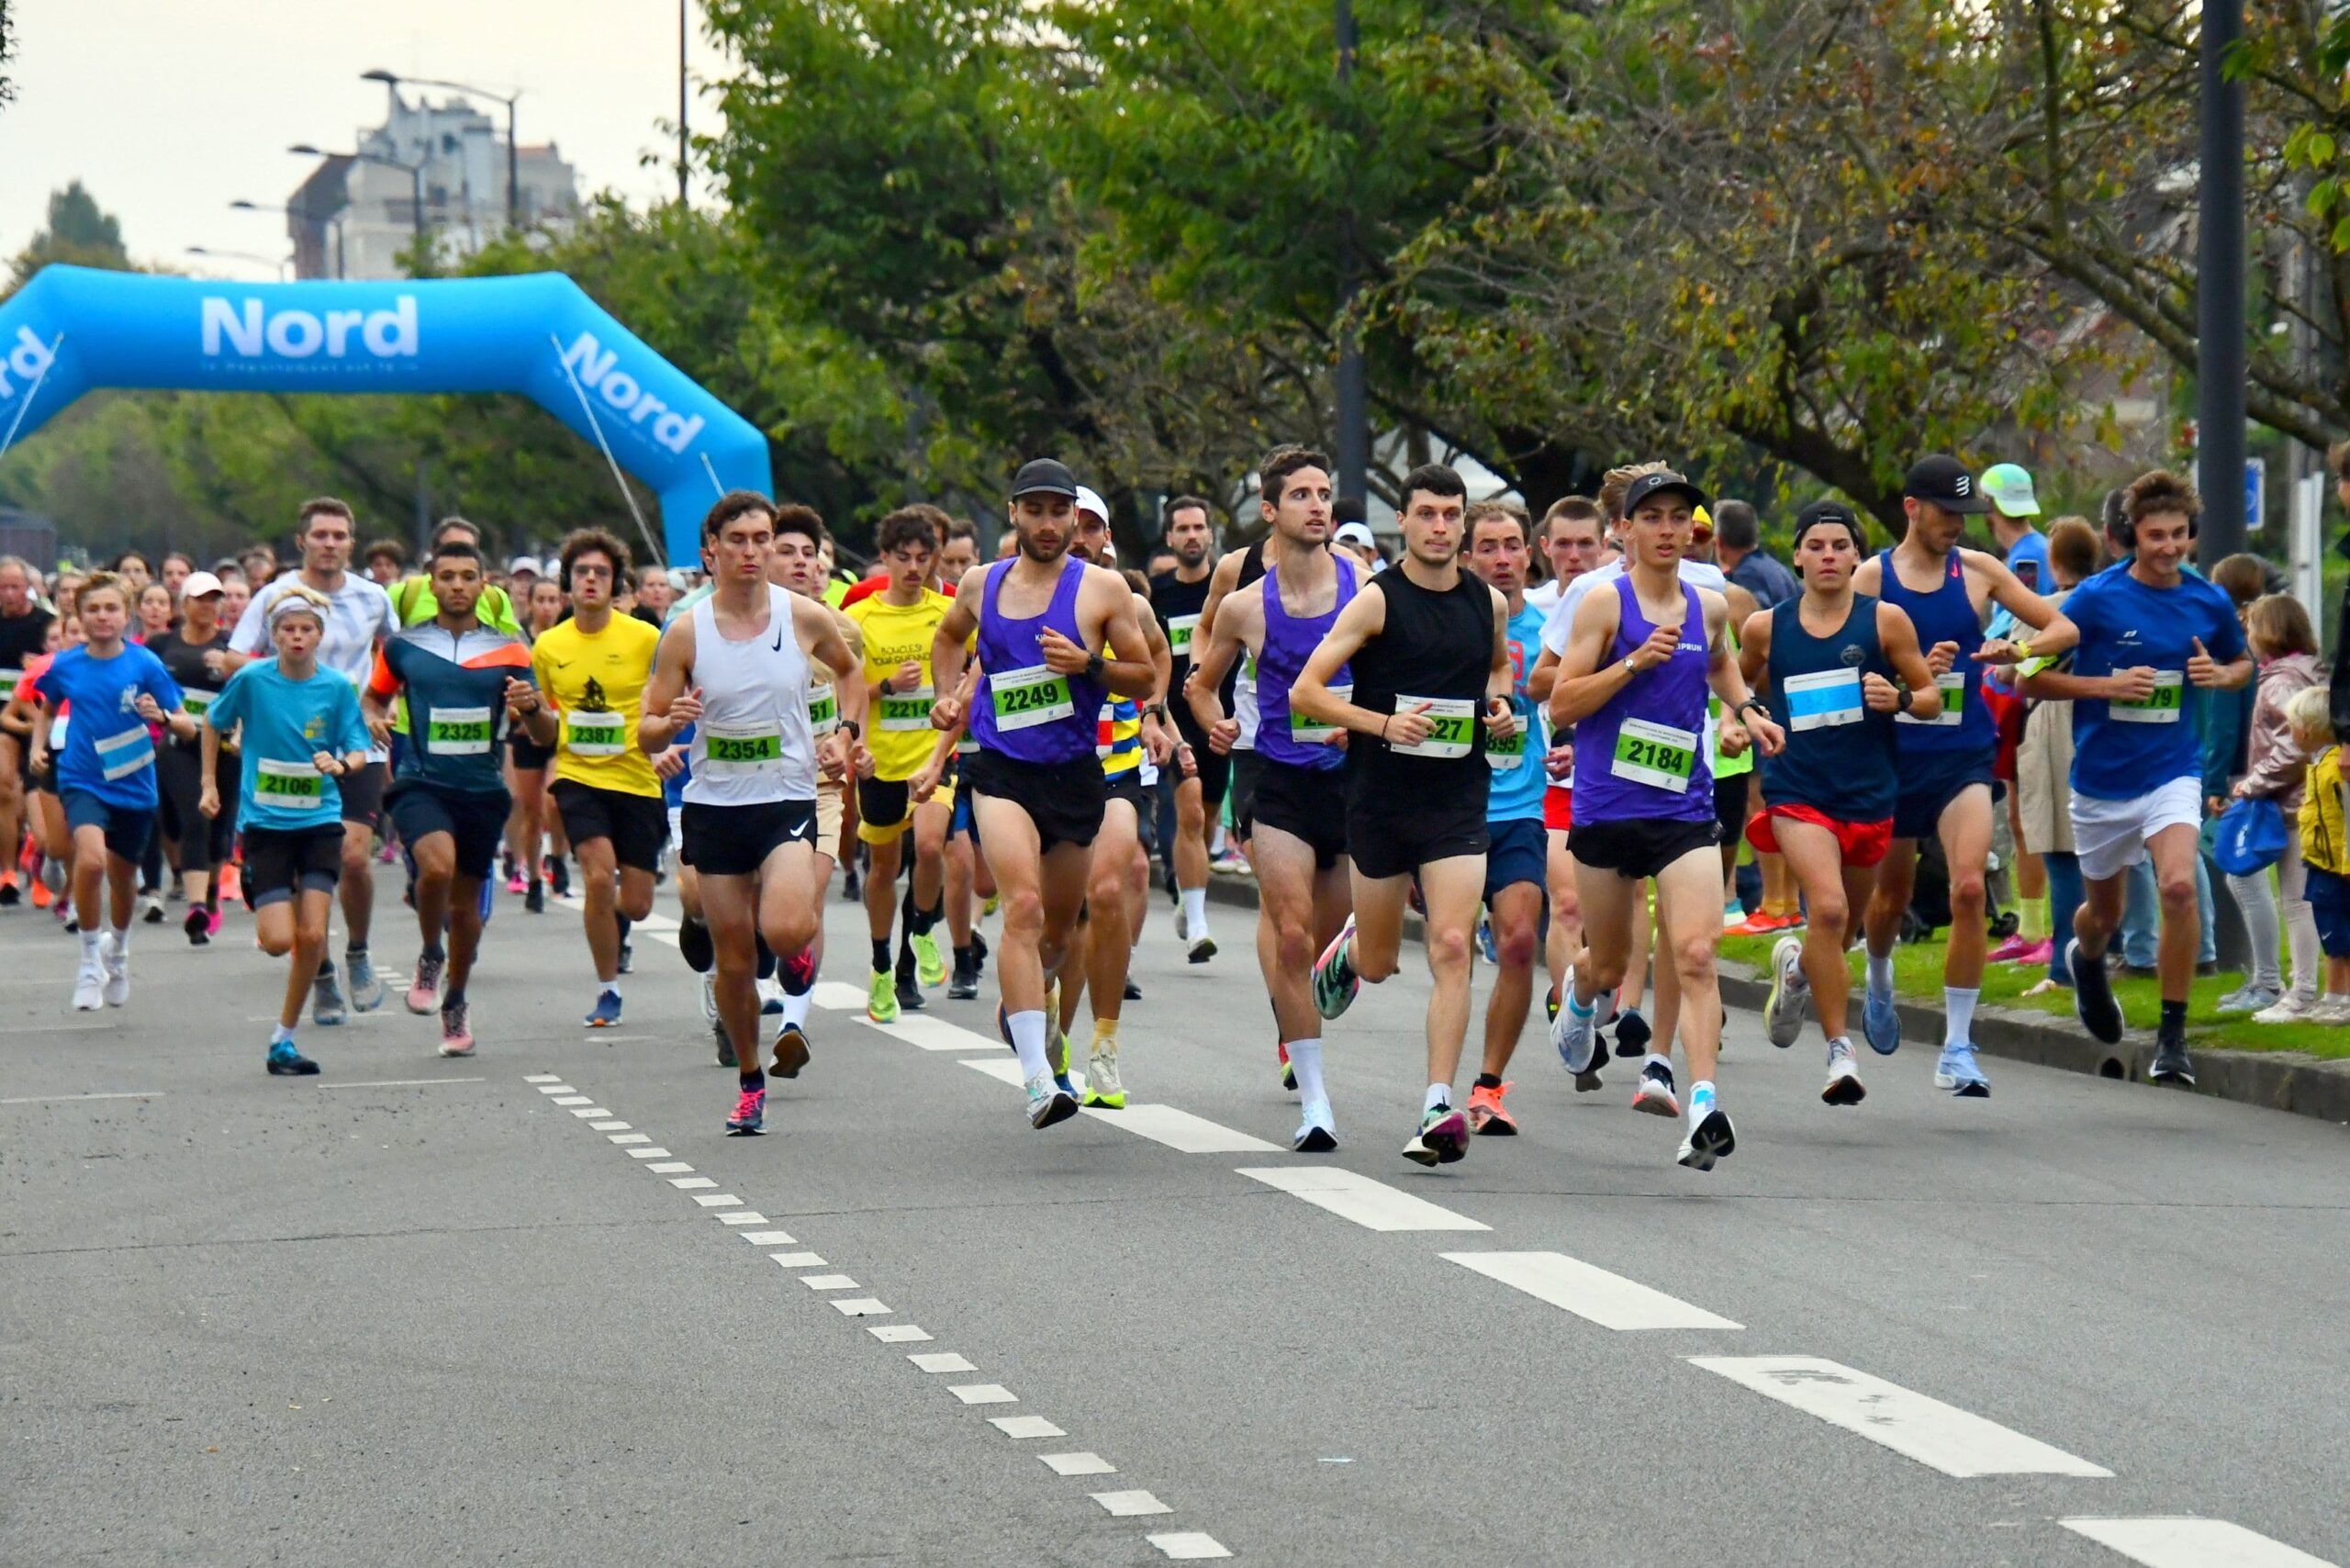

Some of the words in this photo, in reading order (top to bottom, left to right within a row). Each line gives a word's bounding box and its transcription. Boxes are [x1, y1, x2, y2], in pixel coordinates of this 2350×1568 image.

[201, 295, 419, 358] Nord
[562, 330, 706, 454] Nord
[1002, 682, 1058, 713] 2249
[809, 700, 827, 723] 51
[888, 700, 932, 719] 2214
[438, 722, 482, 741] 2325
[575, 726, 616, 744] 2387
[1427, 718, 1463, 740] 27
[717, 739, 770, 760] 2354
[1487, 733, 1518, 753] 895
[1627, 740, 1684, 773] 2184
[265, 775, 313, 796] 2106
